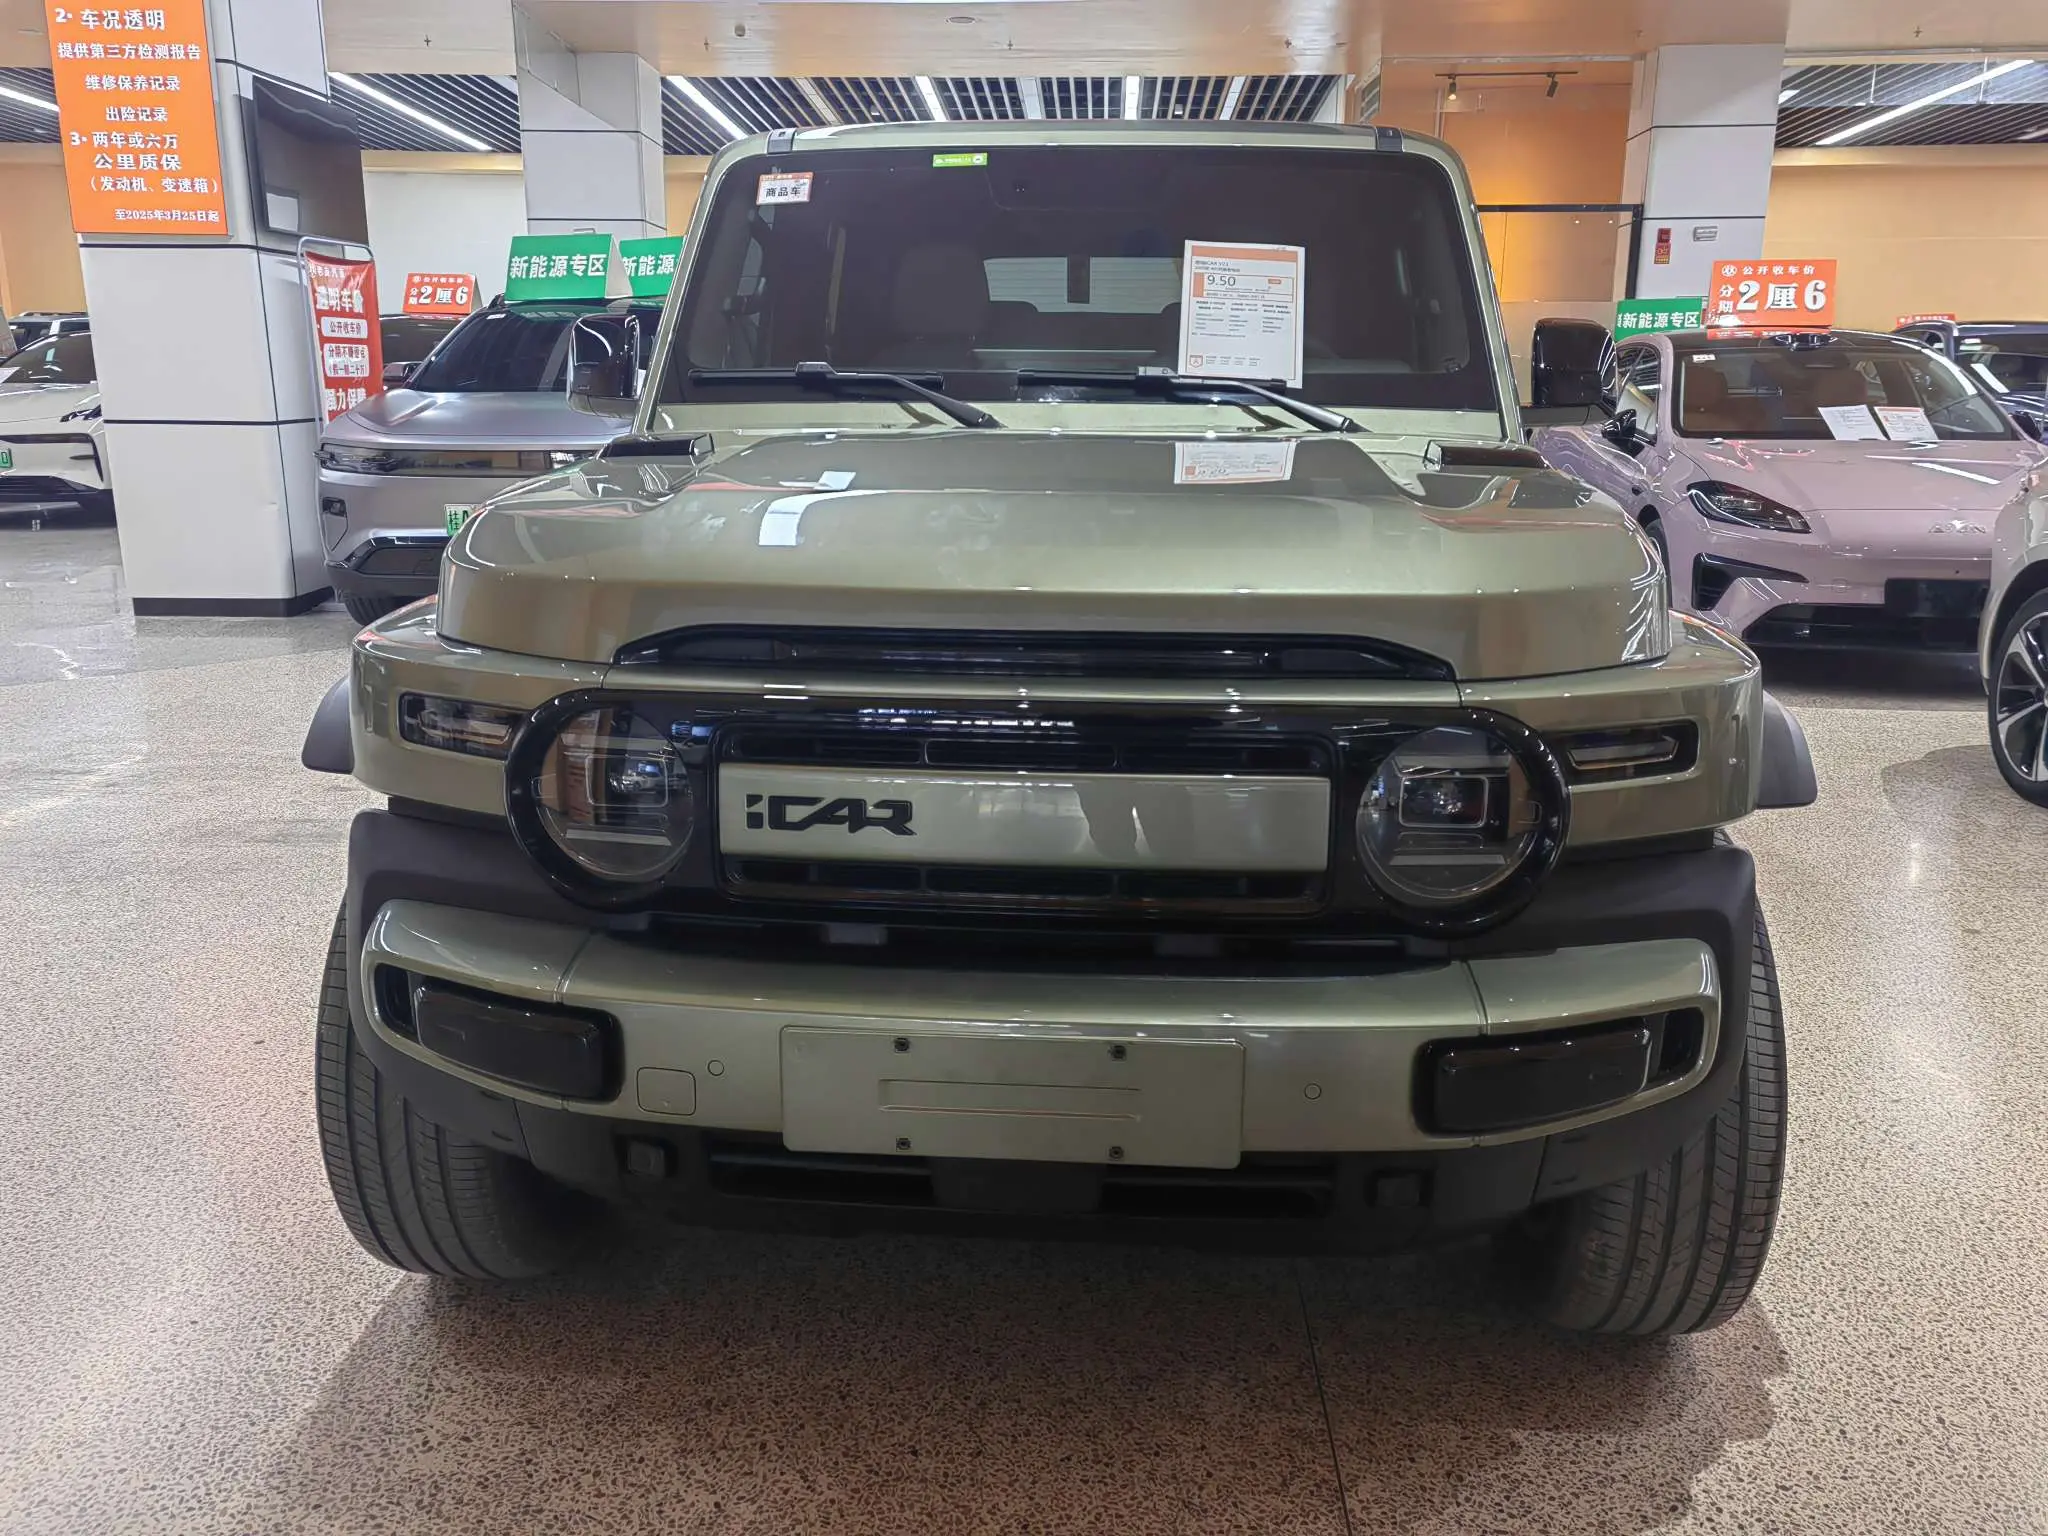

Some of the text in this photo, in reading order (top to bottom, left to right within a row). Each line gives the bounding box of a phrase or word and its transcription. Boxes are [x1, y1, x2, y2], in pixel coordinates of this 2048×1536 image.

[80, 9, 165, 30] 车况透明
[58, 43, 200, 60] 提供第三方检测报告
[85, 75, 180, 91] 维修保养记录
[106, 106, 168, 122] 出险记录
[92, 132, 178, 149] 两年或六万
[93, 153, 181, 171] 公里质保
[766, 186, 800, 198] 商品车
[115, 209, 219, 222] 至2025年3月25日起
[510, 254, 607, 279] 新能源专区
[622, 254, 679, 277] 新能源
[1742, 265, 1815, 275] 公开收车价
[1207, 274, 1236, 287] 9.50
[419, 285, 469, 305] 2厘6
[1718, 284, 1734, 313] 分期
[1736, 280, 1827, 310] 2厘6
[1617, 312, 1699, 328] 新能源专区
